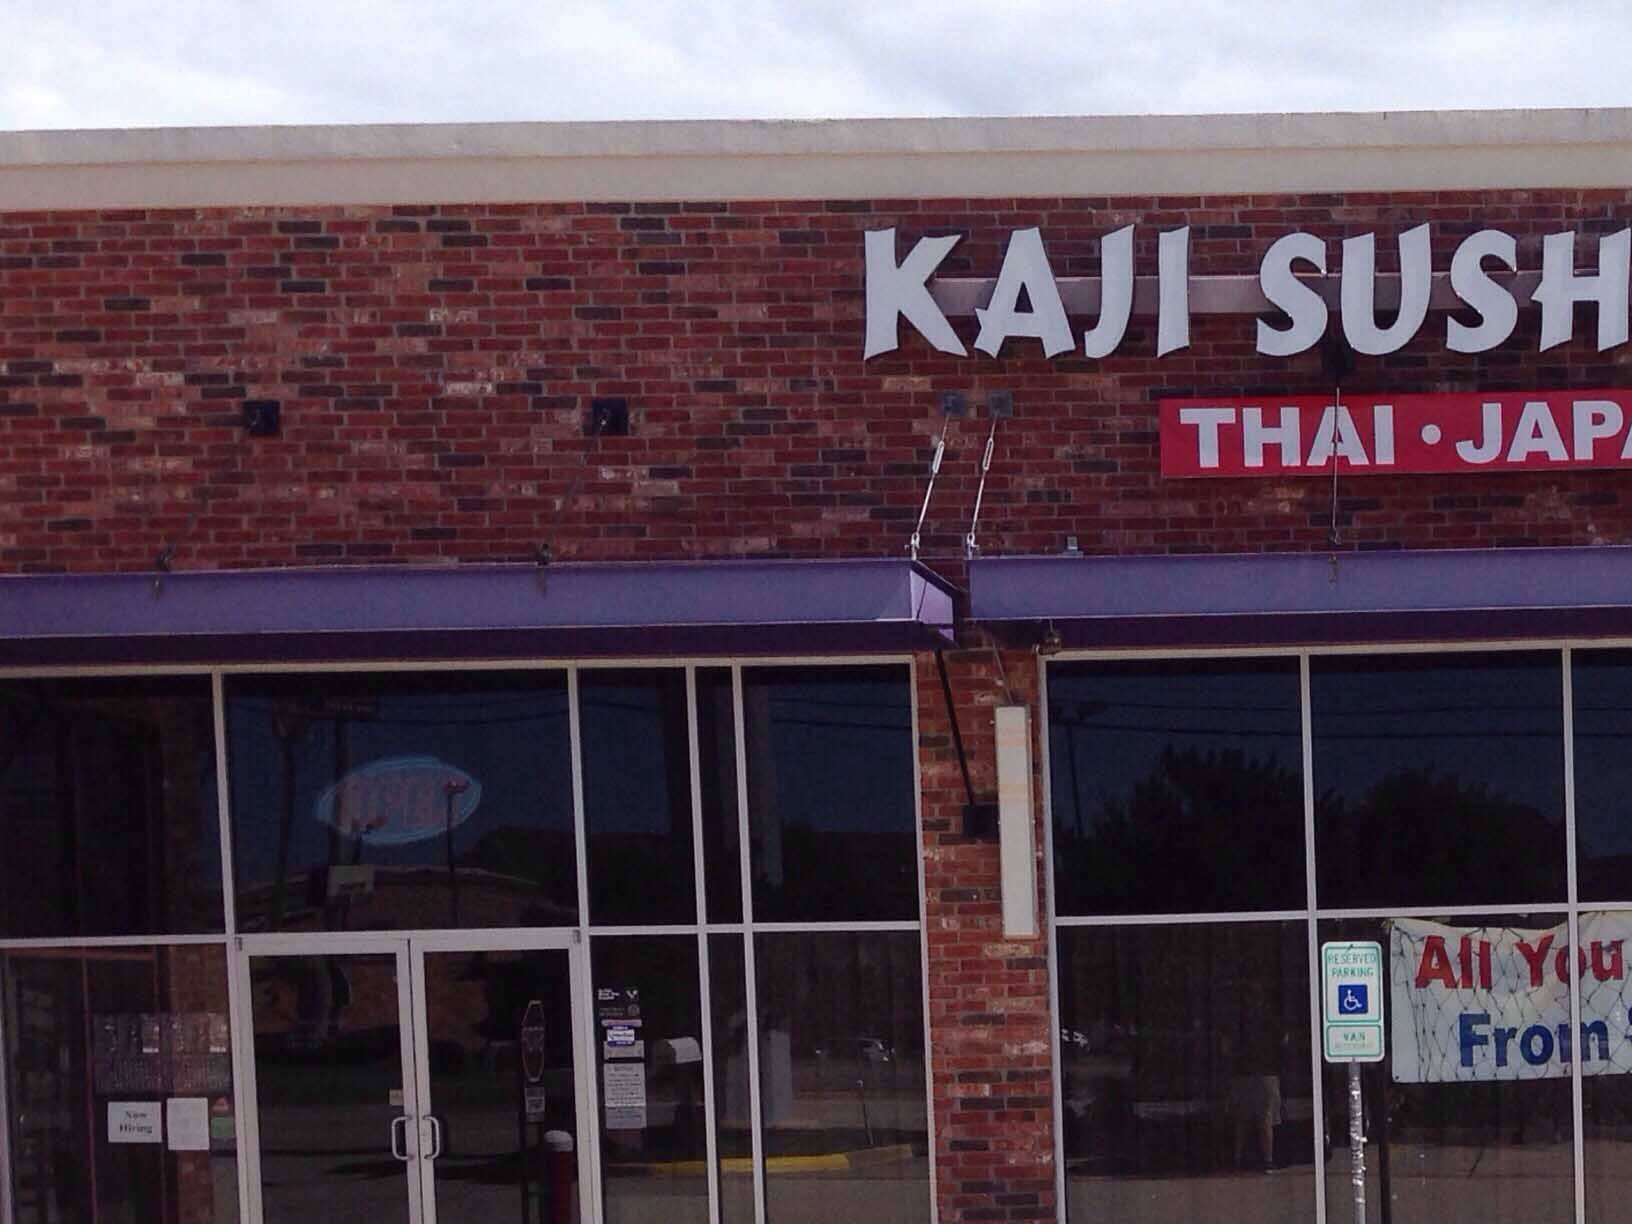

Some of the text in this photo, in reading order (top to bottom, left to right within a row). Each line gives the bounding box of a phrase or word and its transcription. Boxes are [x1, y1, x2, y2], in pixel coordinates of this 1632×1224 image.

[863, 223, 1191, 360] KAJI
[1179, 402, 1396, 469] THAI
[1331, 967, 1374, 978] PARKING
[1415, 935, 1492, 992] All
[1515, 934, 1625, 988] You
[1343, 1032, 1366, 1041] VAN
[1458, 1012, 1611, 1068] From
